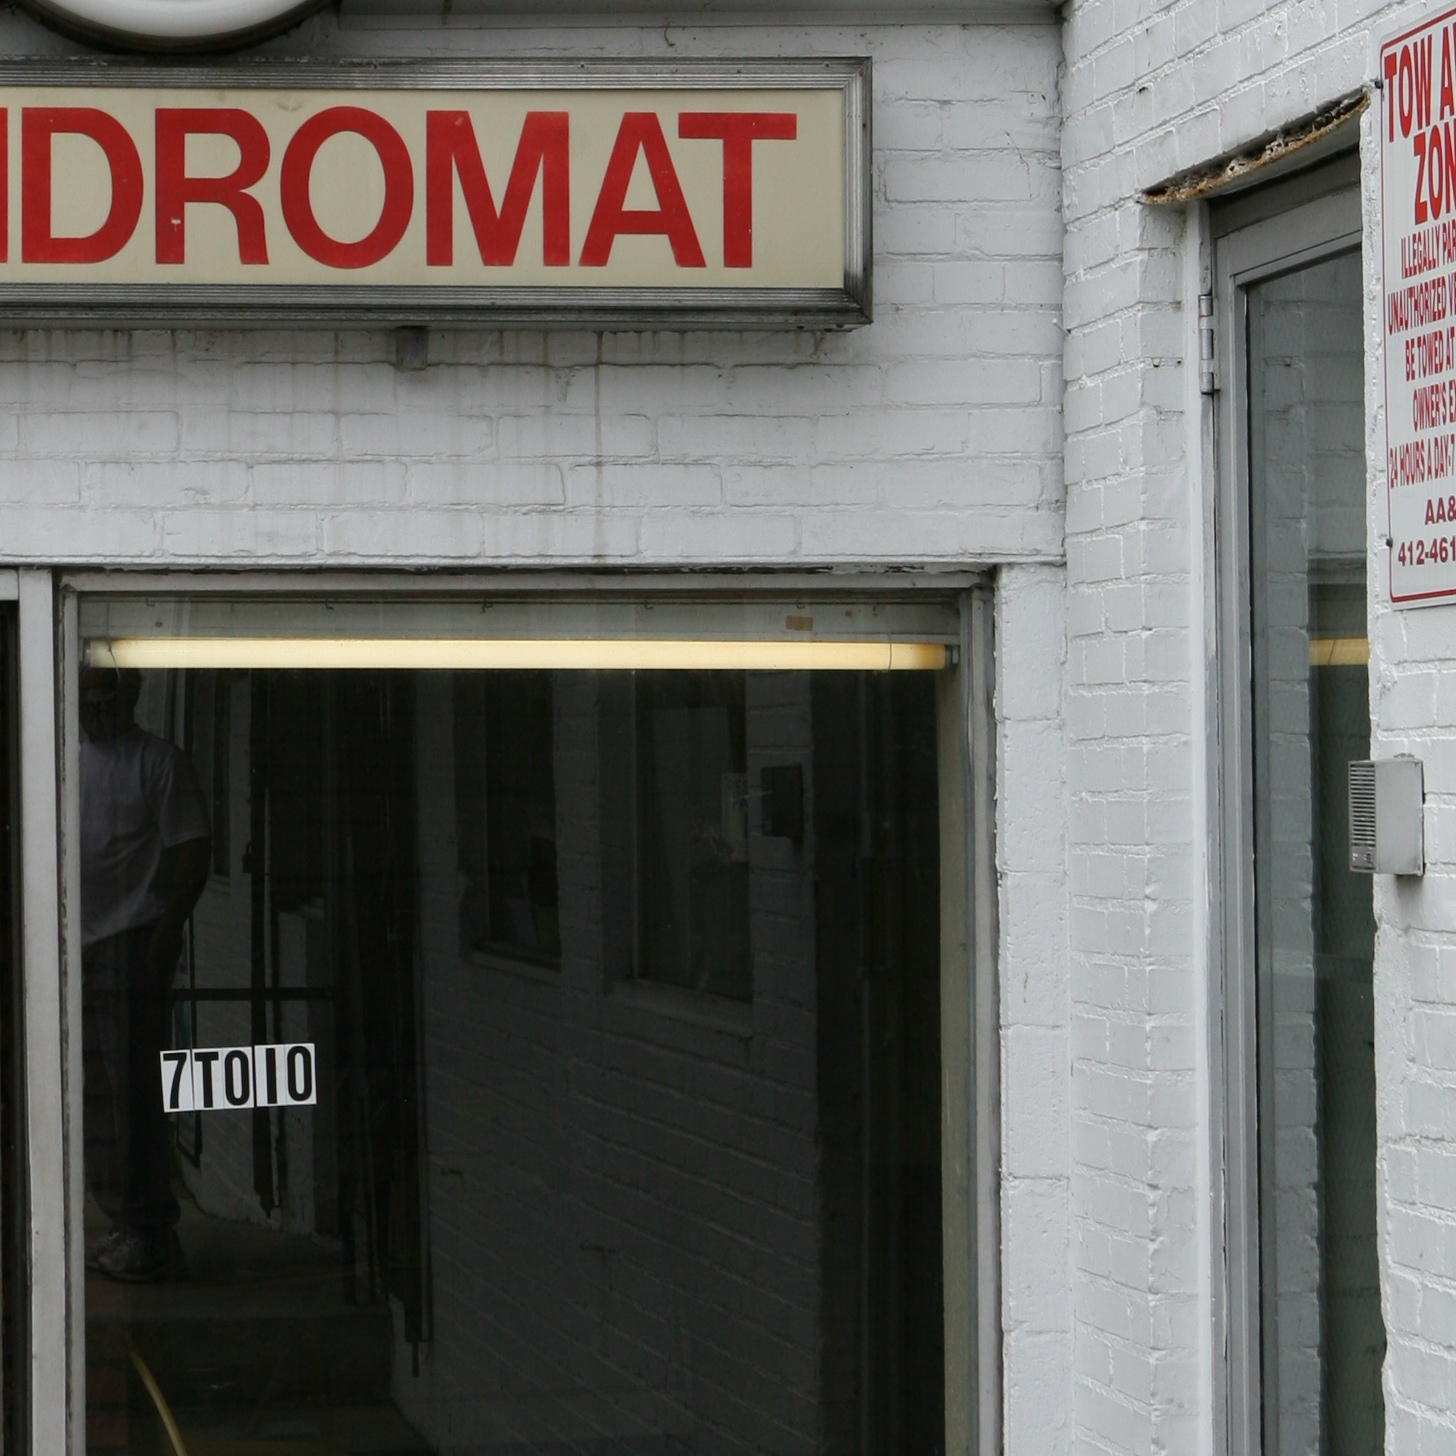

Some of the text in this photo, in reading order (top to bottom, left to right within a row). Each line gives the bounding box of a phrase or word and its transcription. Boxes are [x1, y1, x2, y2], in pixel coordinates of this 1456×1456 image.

[1384, 34, 1432, 143] TOW
[1401, 223, 1441, 280] ILLEGALLY
[1388, 276, 1447, 336] UNAUTHORIZED
[1405, 325, 1455, 382] BE TOWED AT
[1413, 380, 1447, 433] OWNER'S
[1389, 447, 1398, 490] 24
[1399, 439, 1425, 486] HOURS
[1427, 438, 1433, 482] A
